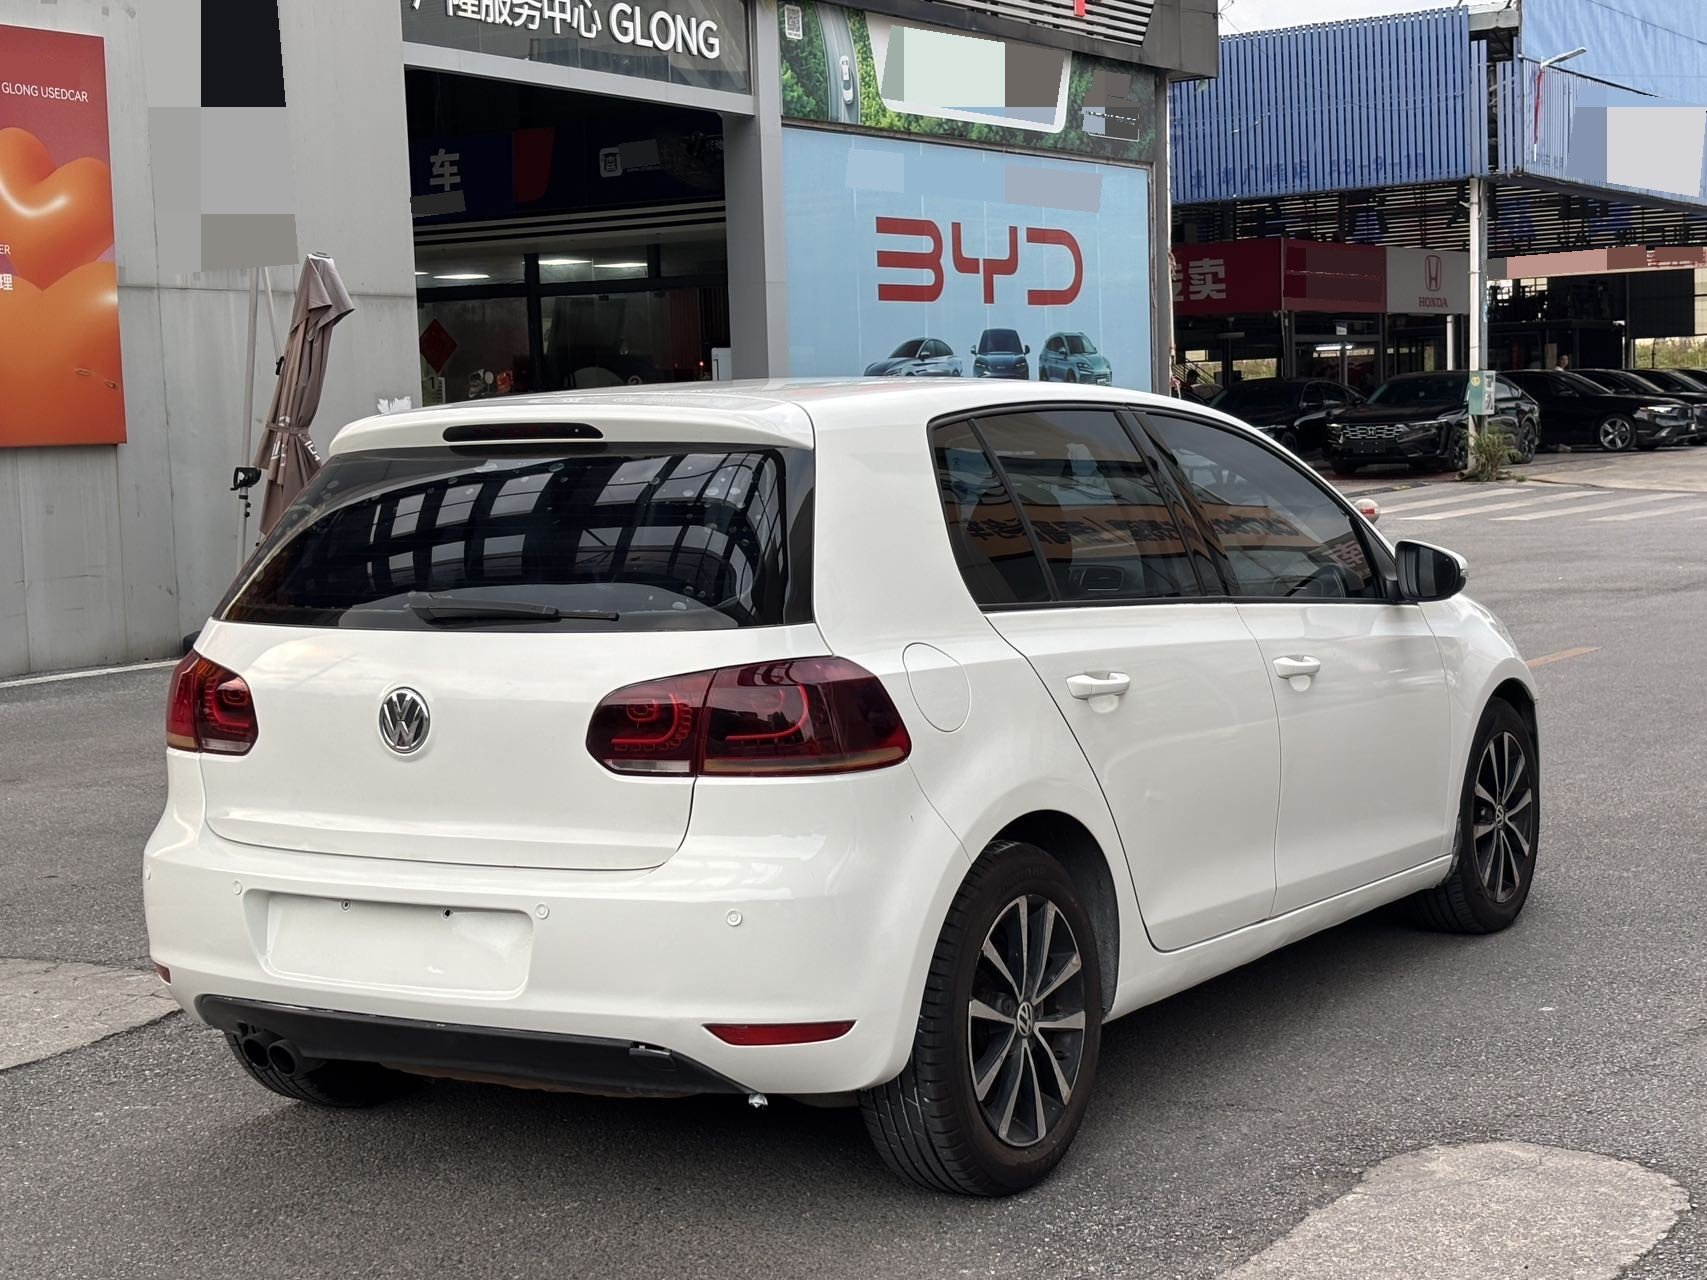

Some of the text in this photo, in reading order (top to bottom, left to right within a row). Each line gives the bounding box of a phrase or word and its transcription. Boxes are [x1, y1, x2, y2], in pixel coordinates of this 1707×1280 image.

[609, 2, 720, 59] GLONG
[1, 81, 89, 103] GLONG USEDCAR
[429, 148, 461, 191] 车
[876, 216, 1083, 305] BYD
[1172, 258, 1226, 301] 卖
[1419, 296, 1449, 308] HONDA
